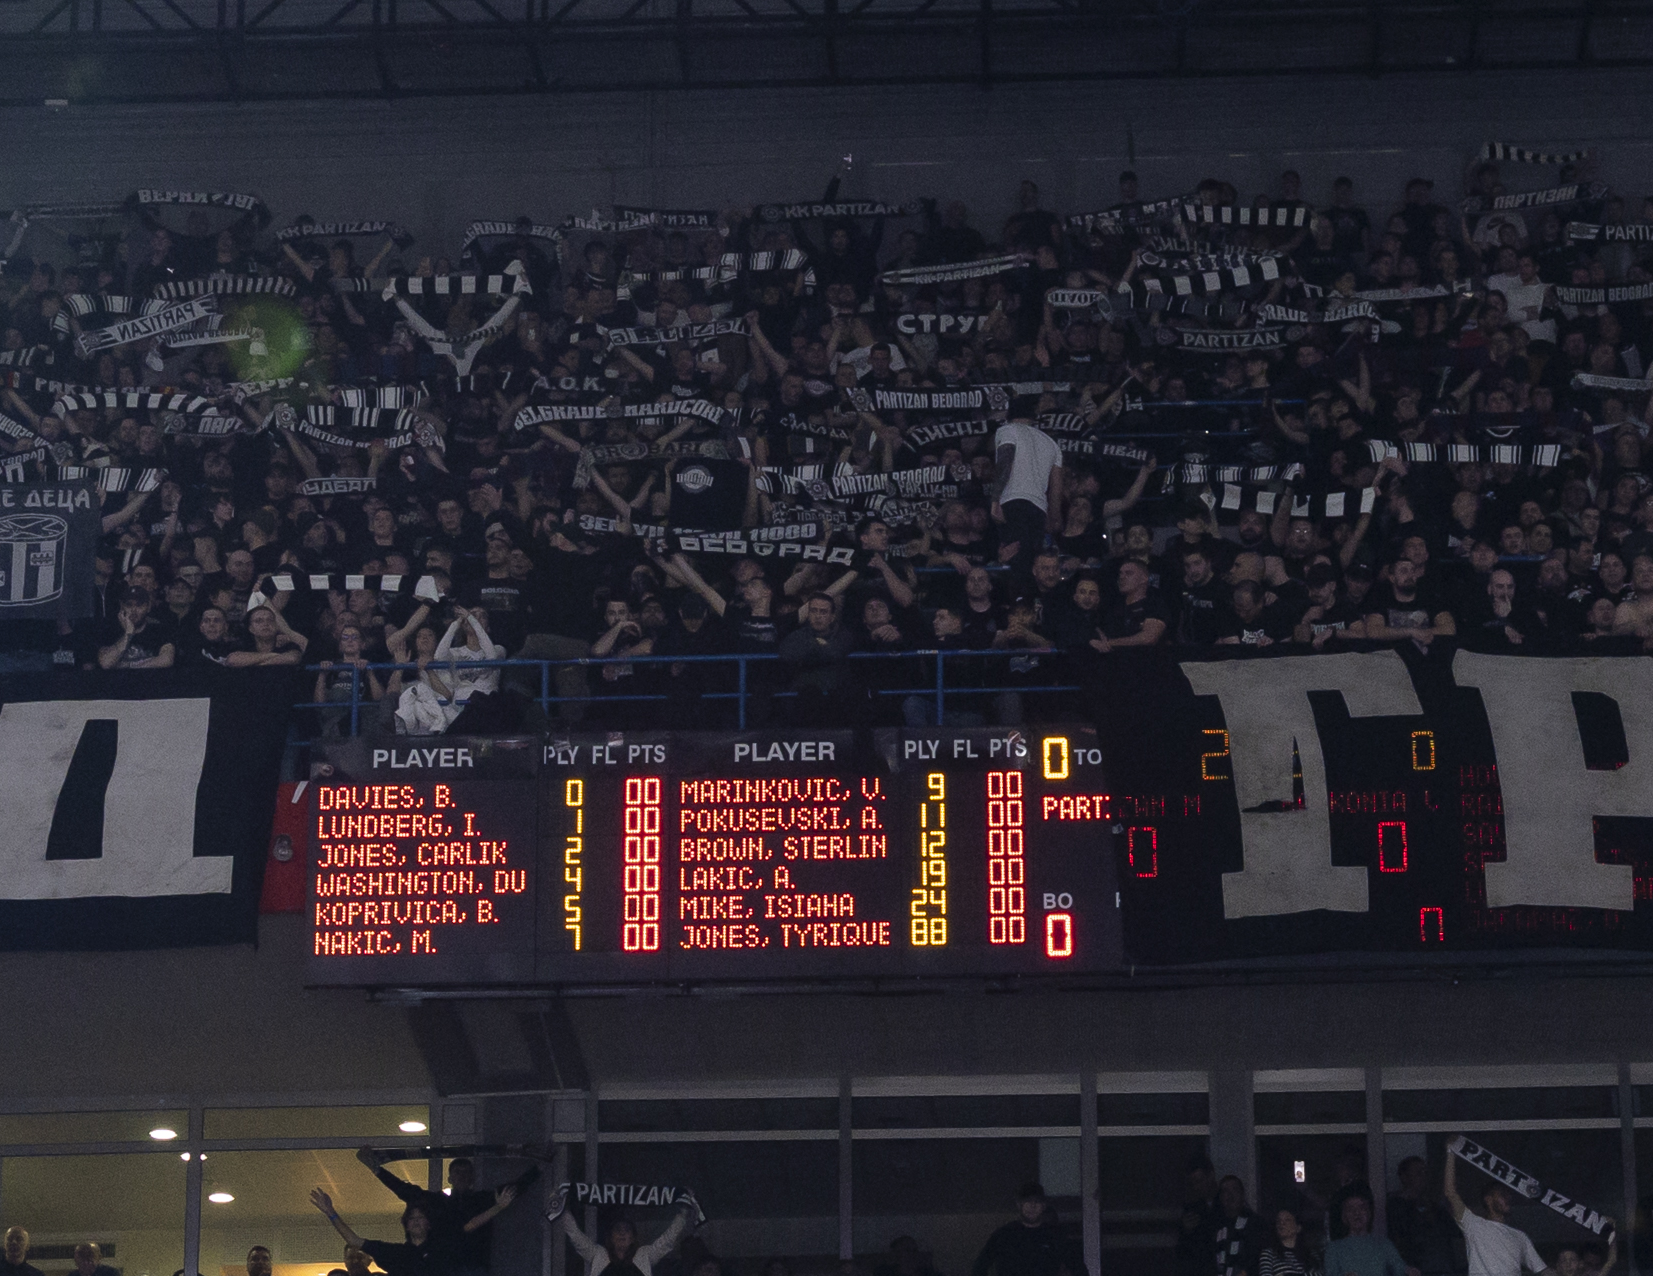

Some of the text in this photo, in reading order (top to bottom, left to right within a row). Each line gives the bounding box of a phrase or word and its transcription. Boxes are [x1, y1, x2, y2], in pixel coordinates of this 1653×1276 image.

[1182, 332, 1280, 348] PARTIZAN
[875, 388, 929, 410] PARTIZAN
[24, 487, 92, 513] ДЕЦА
[373, 738, 1027, 768] PLAYER PLY FL PTS PLAYER PLY FL PTS
[1043, 737, 1069, 779] 0
[1074, 749, 1103, 766] TO
[319, 777, 661, 810] DAVIES, B. 0 00
[680, 771, 1023, 804] MARINKOVIC, V. 9 00
[318, 806, 660, 839] LUNDBERG, I. 1 00
[680, 800, 1023, 831] POKUSEVSKI, A. 11 00
[317, 835, 660, 868] JONES, CARLIK 2 00
[680, 829, 1023, 861] BROWN, STERLIN 12 00
[316, 865, 660, 897] WASHINGTON, DU 4 00
[680, 858, 1023, 891] LAKIC, A. 19 00
[315, 894, 659, 927] KOPRIVICA, B. 5 00
[680, 887, 1024, 919] MIKE, ISIAHA 24 00
[1043, 893, 1073, 909] BO
[314, 922, 659, 956] NAKIC, M. 7 00
[680, 916, 1024, 949] JONES, TYRIQUE 88 00
[1046, 914, 1071, 957] 0
[575, 1181, 676, 1207] PARTIZAN
